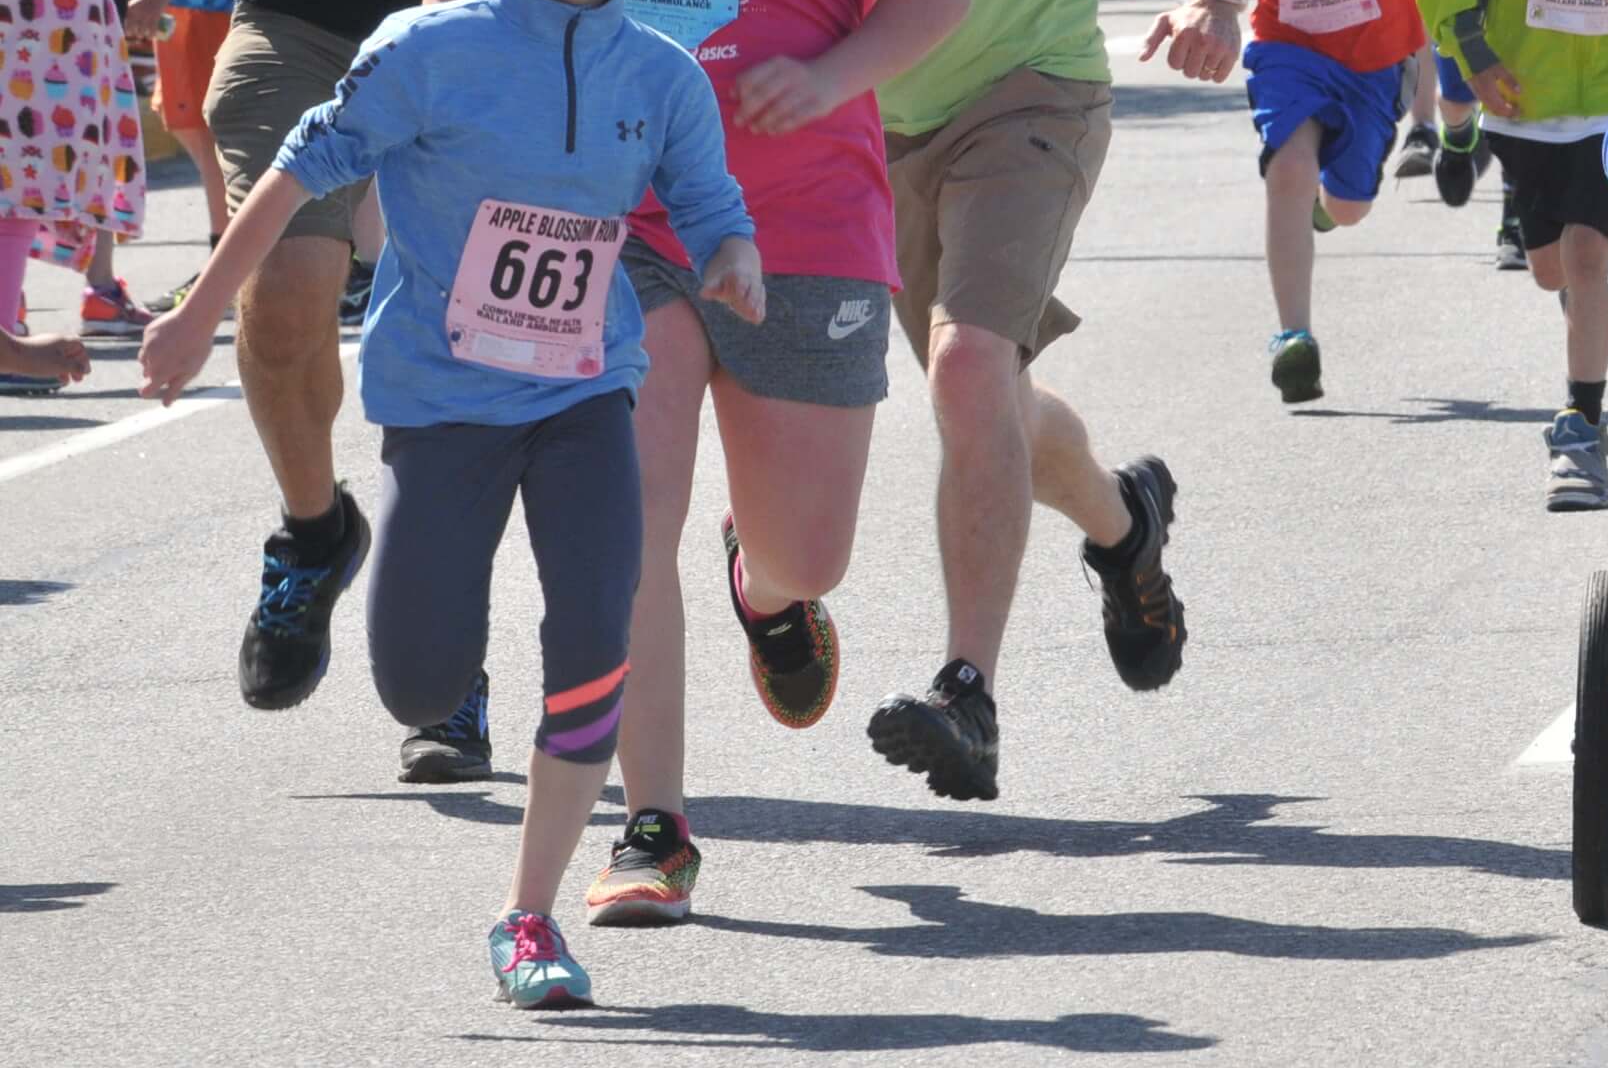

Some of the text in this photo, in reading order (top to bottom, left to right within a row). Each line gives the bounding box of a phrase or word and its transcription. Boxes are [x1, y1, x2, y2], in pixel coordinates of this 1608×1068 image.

[699, 44, 738, 61] asics
[488, 207, 621, 243] APPLE BLOSSOM RUN
[489, 239, 594, 312] 663
[481, 303, 546, 323] CONFLUENCE
[836, 299, 871, 323] NIKE
